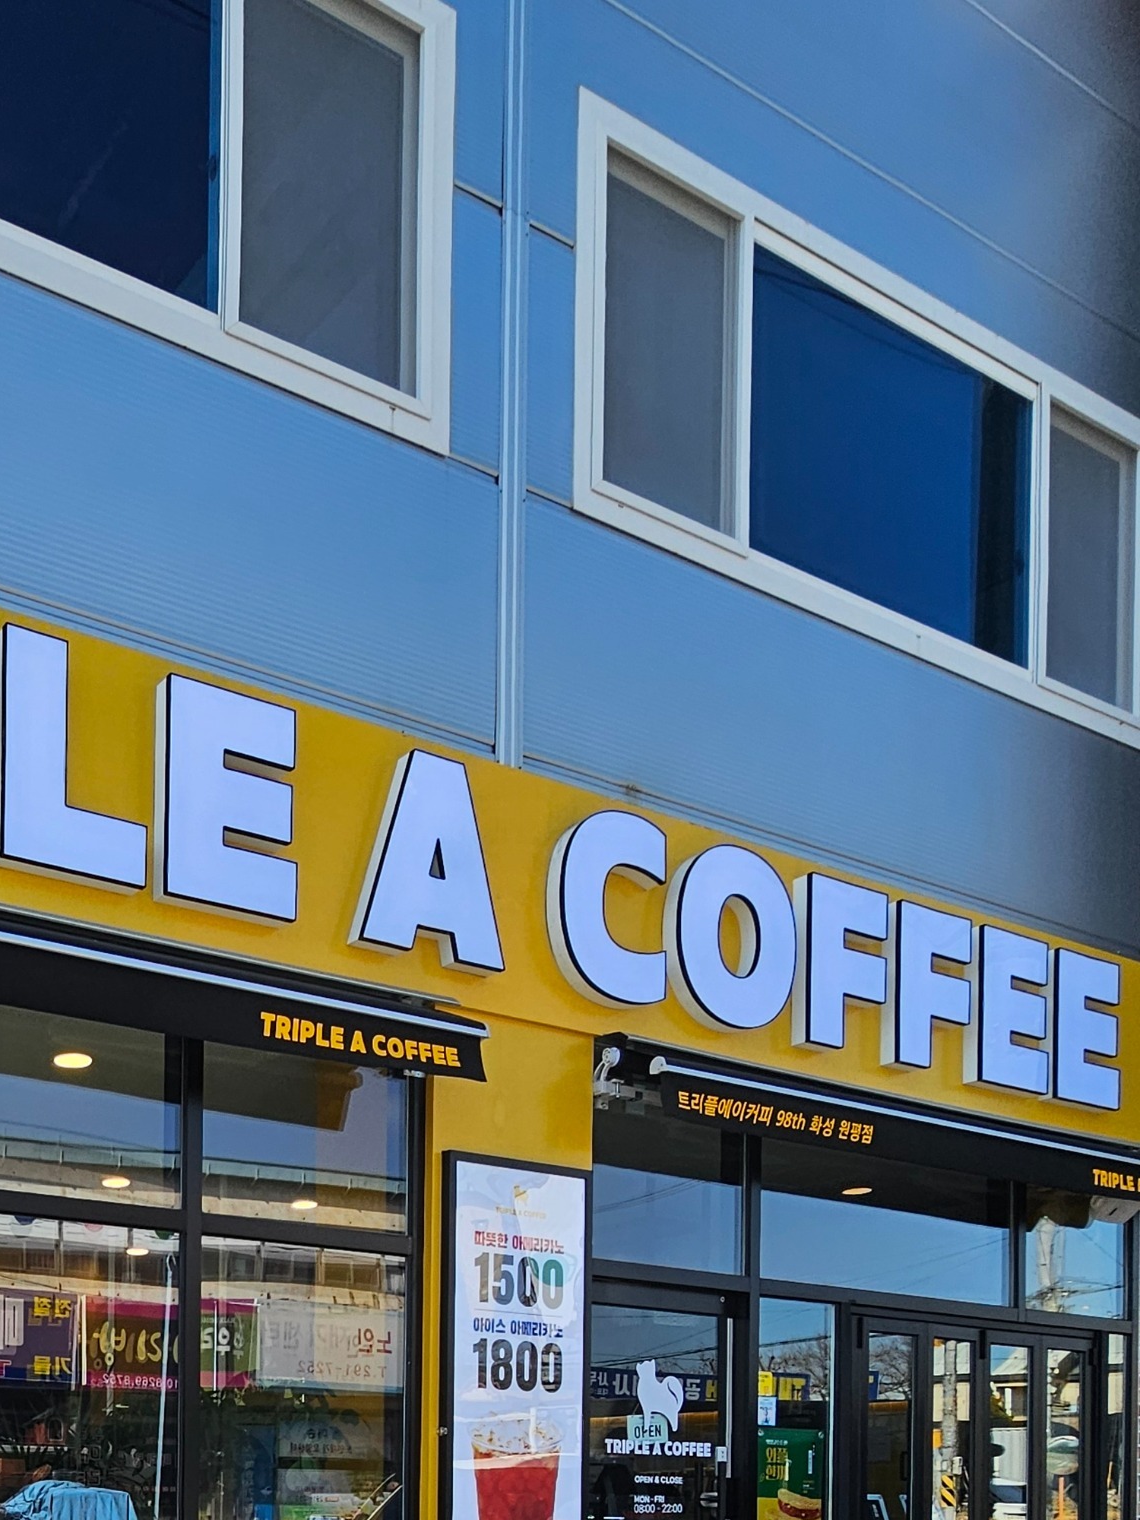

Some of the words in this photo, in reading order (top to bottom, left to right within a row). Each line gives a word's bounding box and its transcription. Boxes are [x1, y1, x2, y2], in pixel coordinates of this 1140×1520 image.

[347, 747, 505, 977] A
[546, 808, 1120, 1113] COFFEE
[261, 1011, 344, 1050] TRIPLE
[350, 1030, 367, 1054] A
[372, 1035, 461, 1067] COFFEE
[678, 1090, 774, 1127] 트리플에이커피
[775, 1110, 806, 1131] 98th
[809, 1115, 836, 1137] 화성
[838, 1120, 874, 1144] 원평점
[1093, 1168, 1135, 1191] TRIPLE
[474, 1230, 508, 1248] 따뜻한
[512, 1234, 564, 1254] 아메리카노
[474, 1252, 564, 1310] 1500
[473, 1317, 506, 1334] 아이스
[510, 1320, 564, 1338] 아메리카노
[473, 1338, 563, 1393] 1800
[605, 1439, 650, 1455] TRIPLE
[652, 1442, 662, 1456] A
[664, 1441, 711, 1457] COFFEE
[634, 1475, 654, 1483] OPEN
[661, 1476, 683, 1484] CLOSE
[662, 1504, 682, 1513] 22:00
